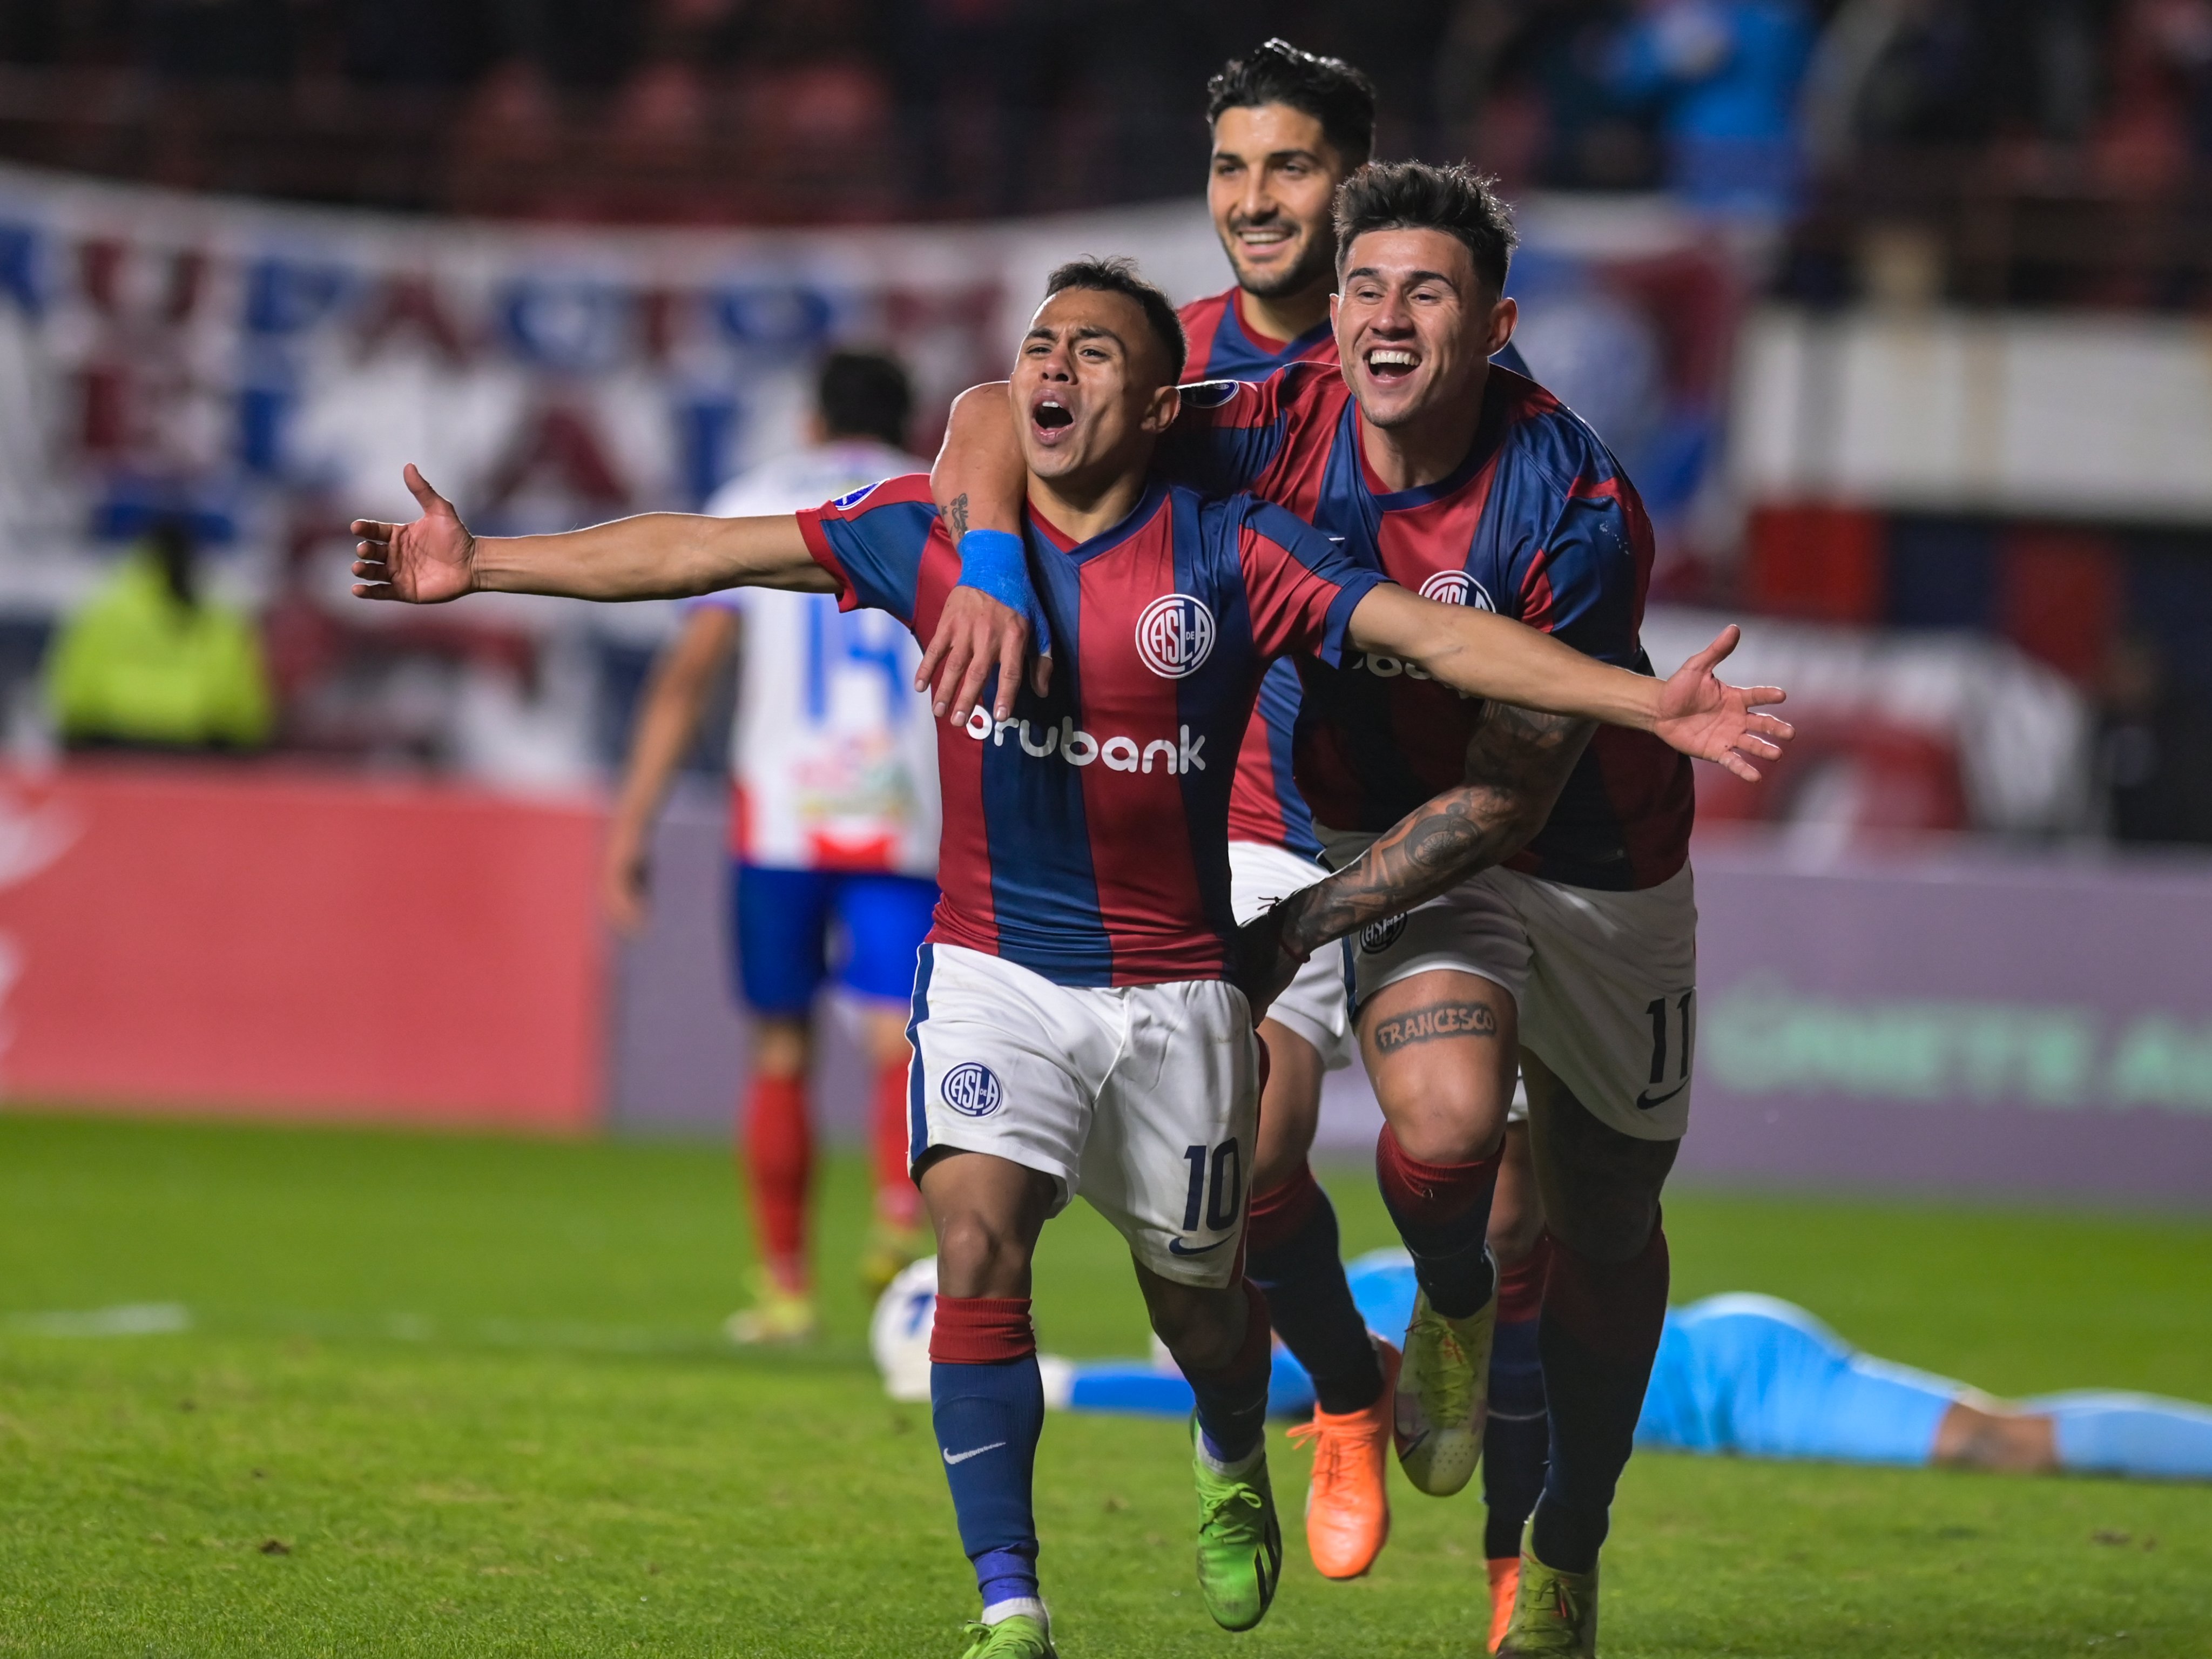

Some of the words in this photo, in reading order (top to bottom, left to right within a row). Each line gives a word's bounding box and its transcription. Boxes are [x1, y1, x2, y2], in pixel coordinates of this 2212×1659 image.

[1378, 1008, 1494, 1048] FRANCESCO
[1646, 992, 1691, 1084] 11
[1183, 1137, 1241, 1232] 10
